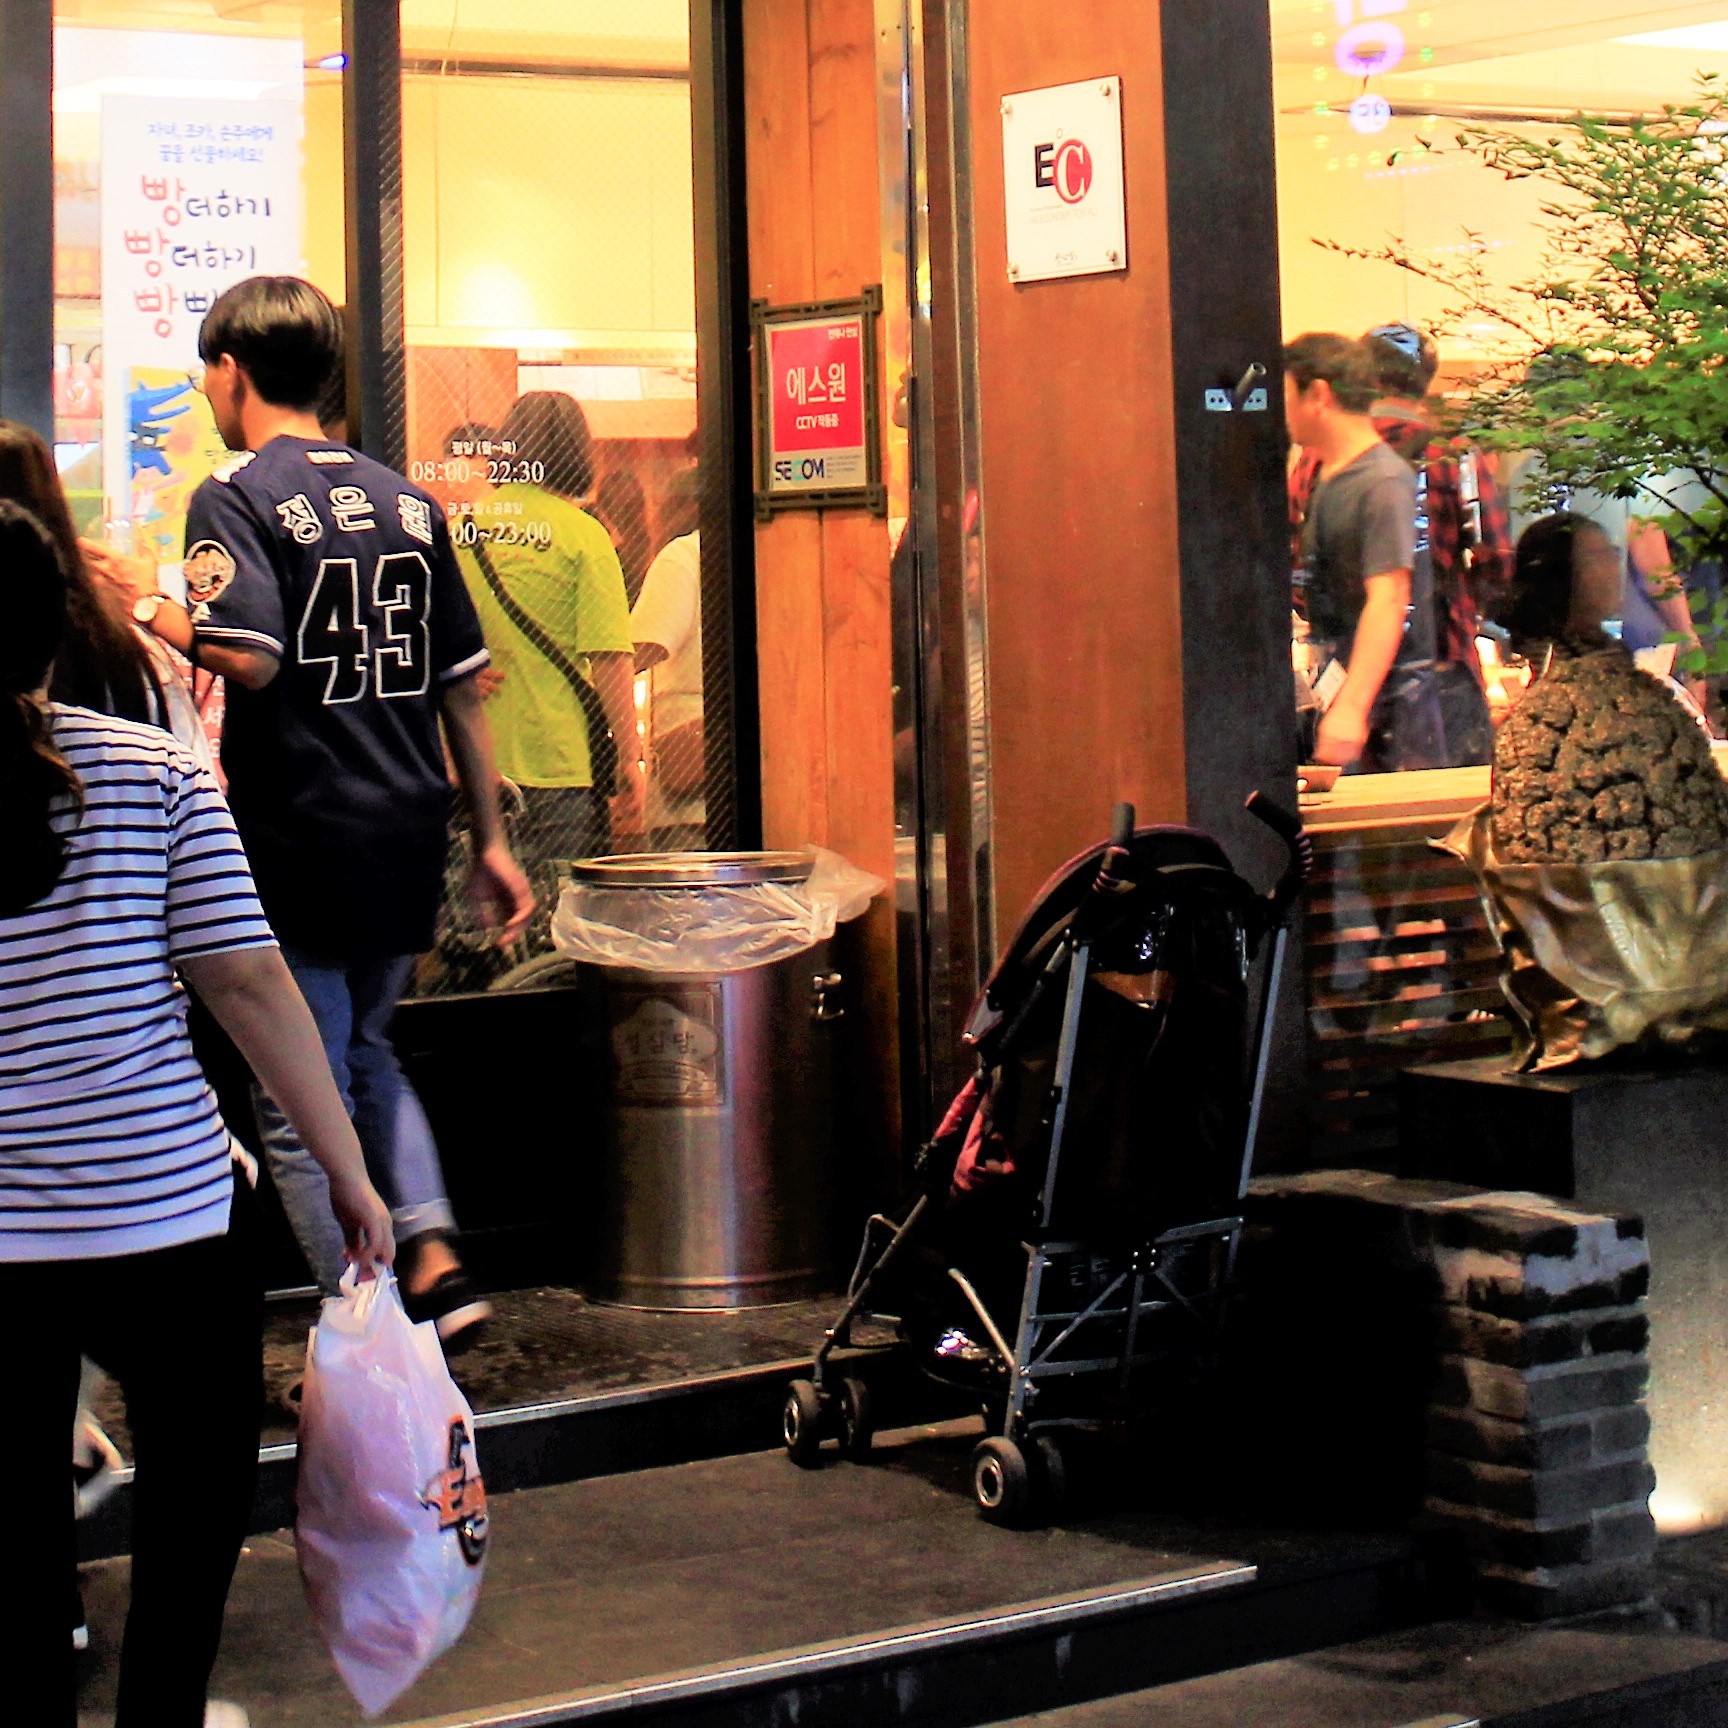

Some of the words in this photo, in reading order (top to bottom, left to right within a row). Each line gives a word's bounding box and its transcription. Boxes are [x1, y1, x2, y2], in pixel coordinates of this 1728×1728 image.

[786, 362, 846, 405] 에스원
[410, 459, 546, 484] 08:00~22:30
[775, 458, 825, 480] SECOM
[298, 552, 433, 705] 43
